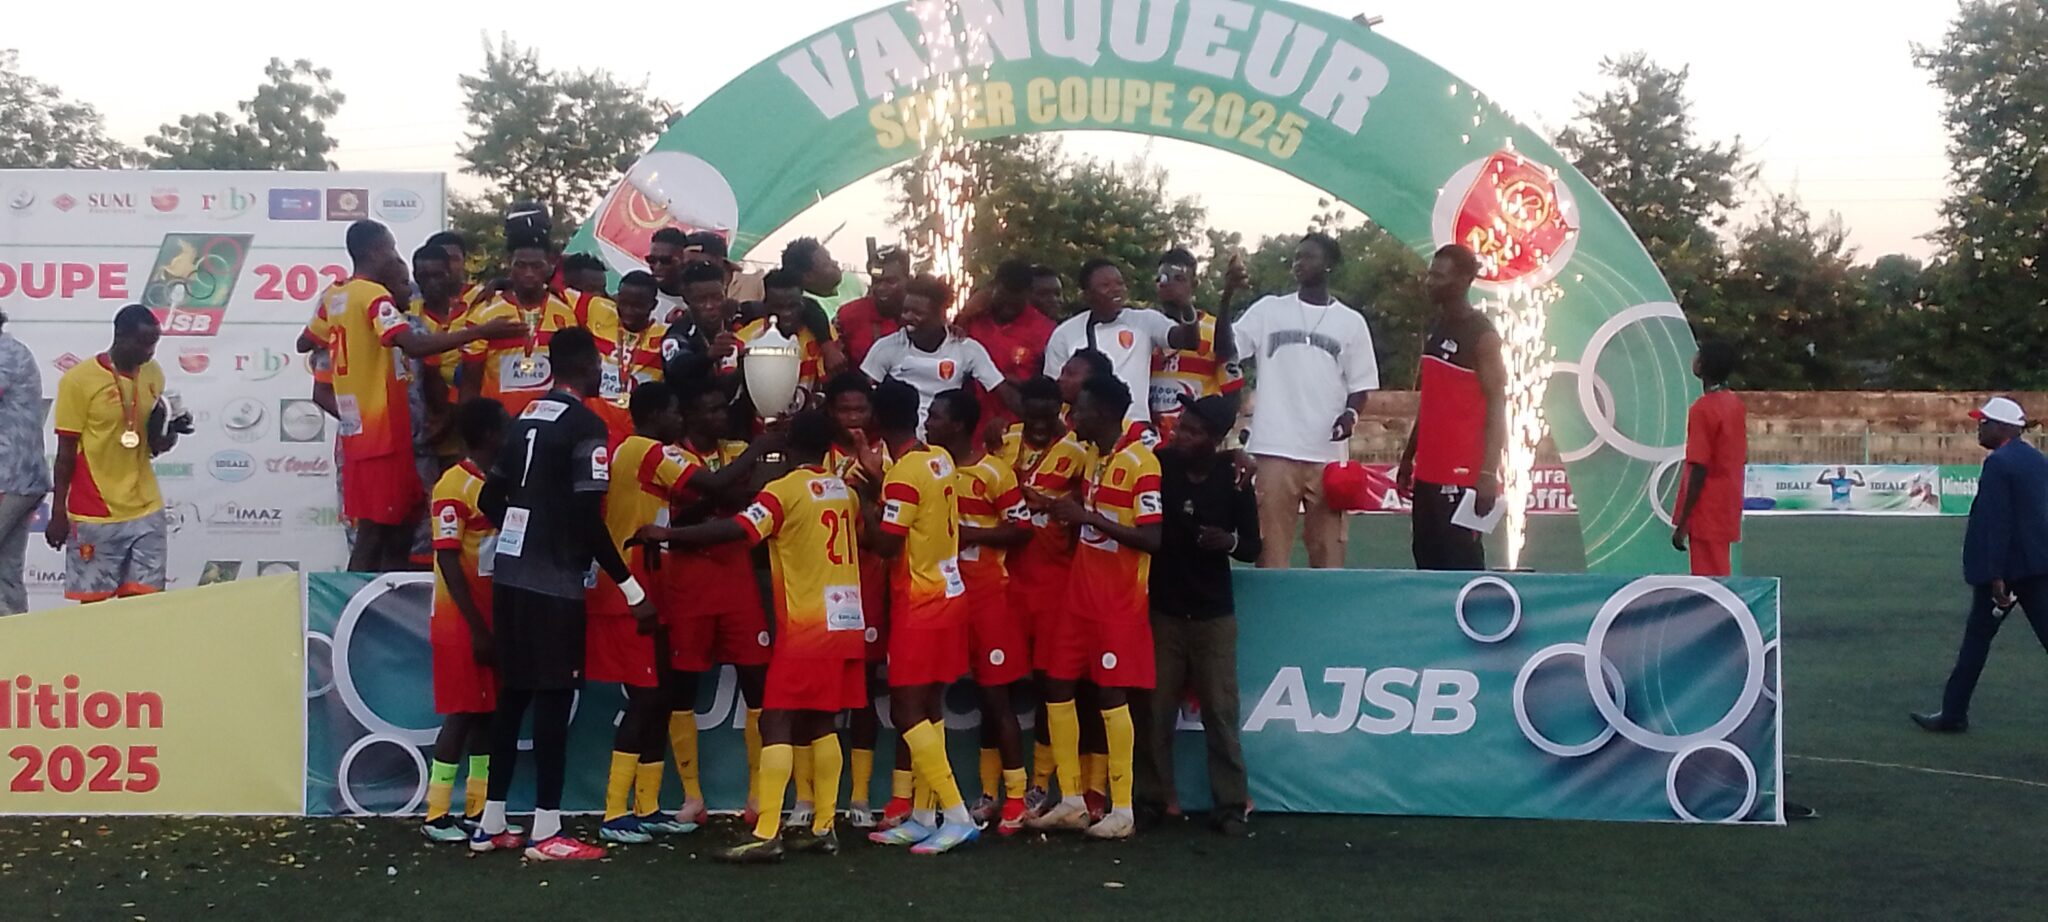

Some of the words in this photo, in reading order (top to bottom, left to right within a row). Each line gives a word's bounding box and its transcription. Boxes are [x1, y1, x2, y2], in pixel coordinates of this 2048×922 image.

[777, 0, 1389, 135] VAINQUEUR
[1027, 77, 1175, 126] COUPE
[1182, 86, 1308, 158] 2025
[89, 193, 136, 207] SUNU
[521, 428, 538, 487] 1
[236, 508, 282, 520] IMAZ
[820, 509, 855, 566] 21
[1243, 666, 1480, 734] AJSB
[8, 745, 160, 792] 2025
